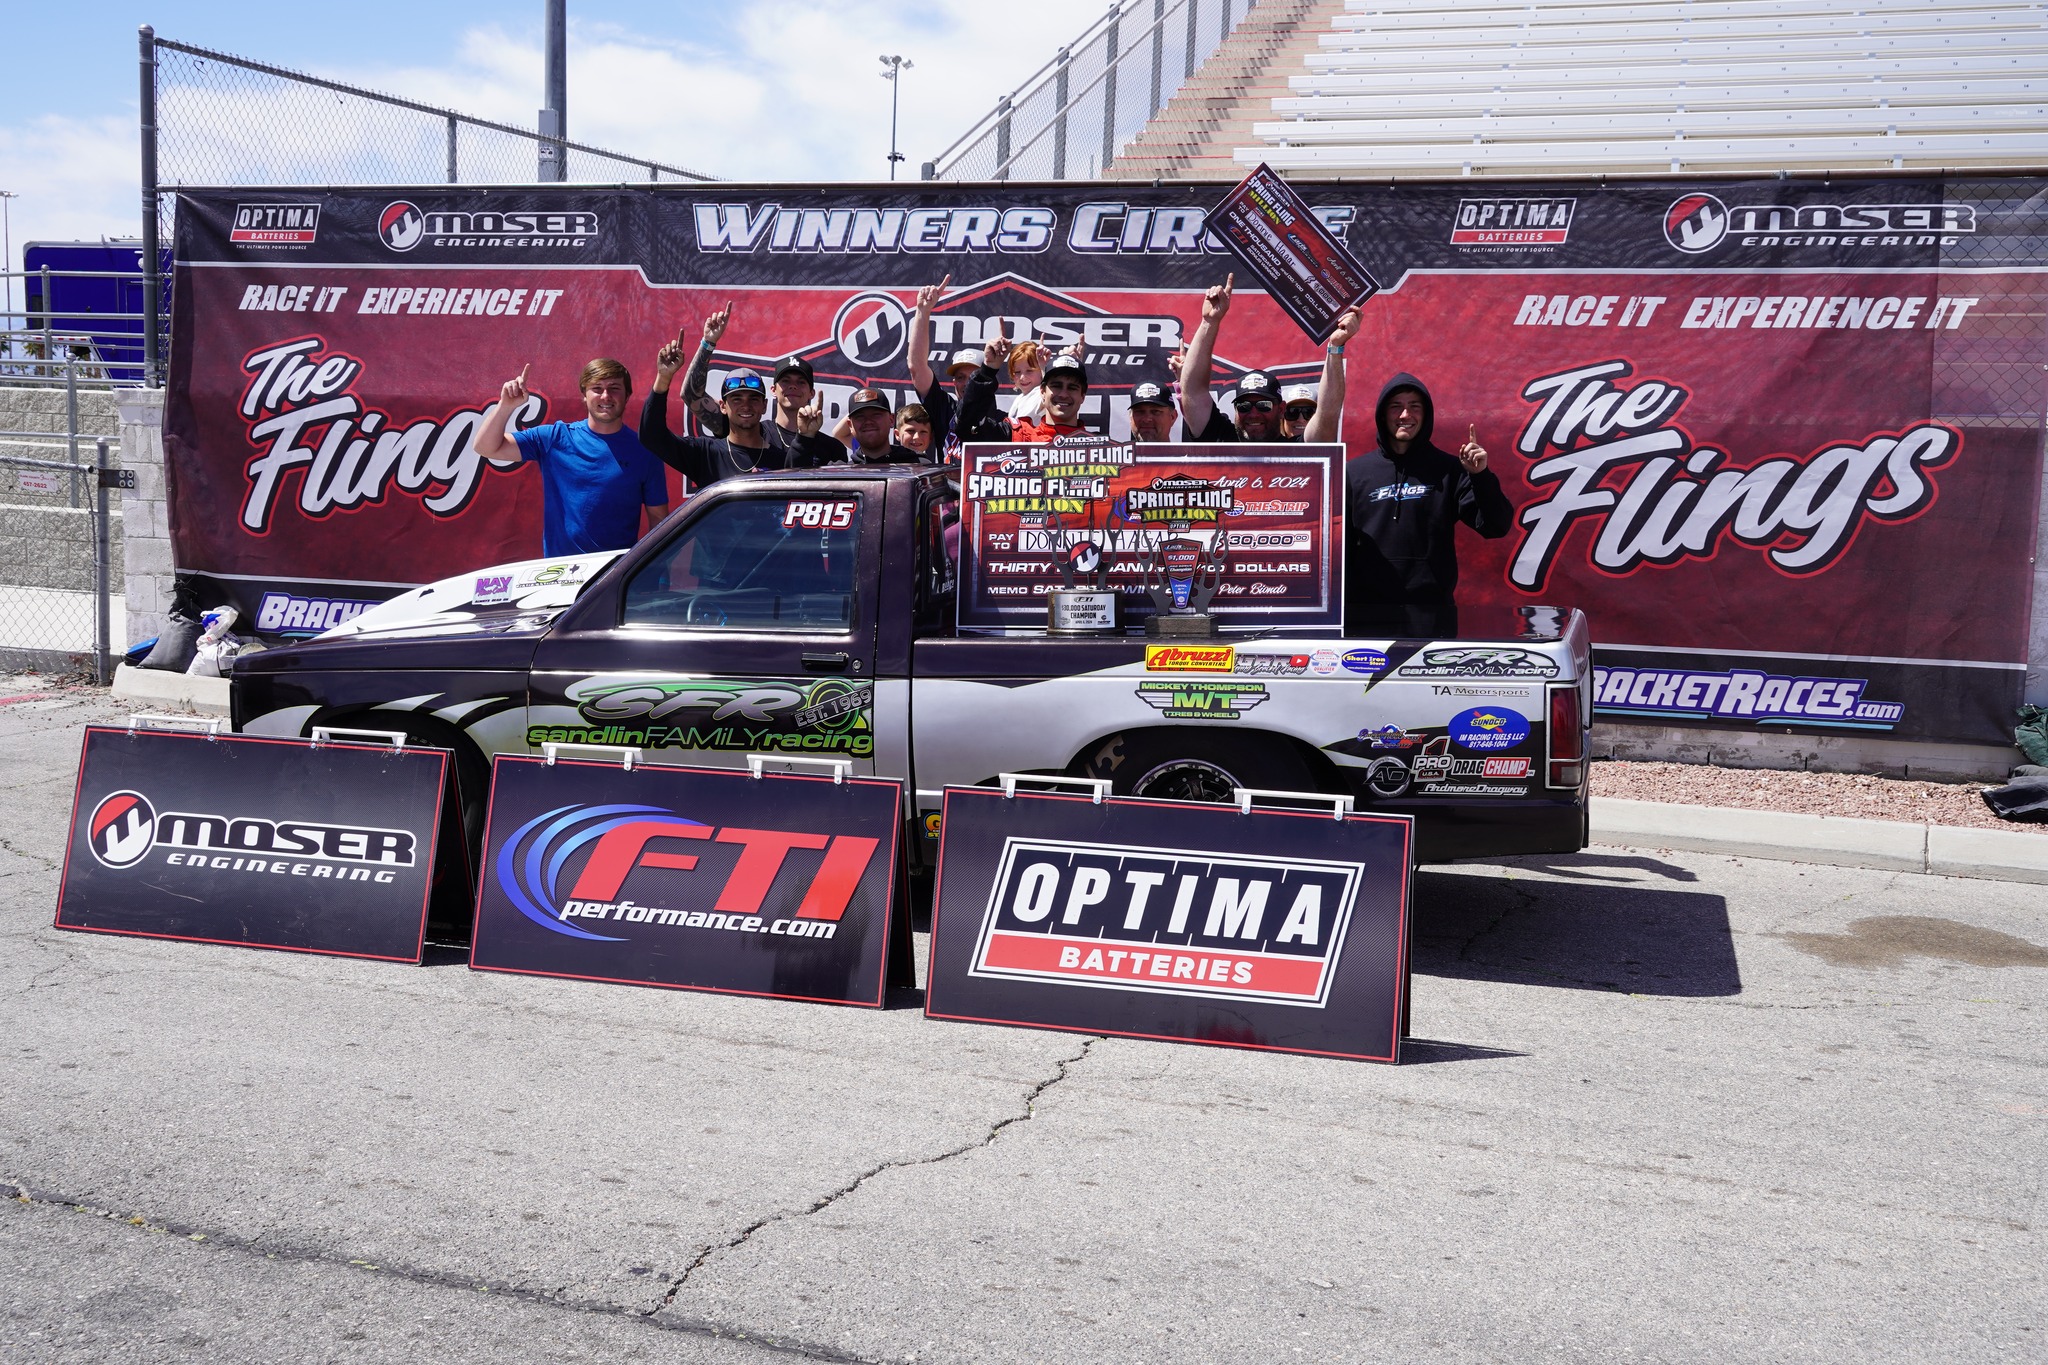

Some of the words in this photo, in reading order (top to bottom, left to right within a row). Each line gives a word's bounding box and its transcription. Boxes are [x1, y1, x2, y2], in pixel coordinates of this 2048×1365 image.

[1247, 176, 1277, 206] SPRING
[1271, 201, 1296, 226] FLING
[1248, 190, 1282, 225] MILLION
[239, 209, 313, 227] OPTIMA
[424, 213, 598, 235] MOSER
[1461, 204, 1566, 226] OPTIMA
[1727, 205, 1977, 233] MOSER
[694, 204, 1054, 252] WINNERS
[1068, 202, 1355, 254] CIRE
[434, 238, 586, 246] ENGINEERING
[1741, 236, 1959, 246] ENGINEERING
[1229, 211, 1245, 228] ONE
[1243, 226, 1282, 266] THOUSAND
[1304, 293, 1330, 320] DOLLARS
[240, 286, 314, 311] RACE
[314, 287, 347, 312] IT
[358, 288, 528, 315] EXPERIENCE
[527, 289, 563, 315] IT
[1514, 296, 1618, 326] RACE
[1617, 296, 1667, 327] IT
[1680, 297, 1929, 329] EXPERIENCE
[1925, 298, 1978, 330] IT
[909, 316, 1181, 347] MOSER
[244, 340, 356, 414] The
[1520, 362, 1680, 453] The
[244, 396, 543, 528] Flings
[992, 452, 1012, 461] RACE
[1031, 448, 1085, 466] SPRING
[1090, 445, 1133, 463] FLING
[1044, 466, 1120, 477] MILLION
[1209, 476, 1249, 489] April
[1269, 476, 1310, 489] 2024
[969, 475, 1042, 498] SPRING
[986, 500, 1085, 513] MILLION
[1130, 491, 1184, 508] SPRING
[1189, 489, 1231, 508] FLING
[1510, 427, 1951, 586] Flings
[784, 502, 854, 526] P815
[1143, 509, 1217, 521] MILLION
[989, 563, 1052, 572] THIRTY
[1236, 564, 1310, 572] DOLLARS
[476, 577, 512, 594] MAY
[1219, 584, 1247, 595] Peter
[1250, 583, 1286, 595] Biondo
[1149, 648, 1231, 666] Abruzzi
[1174, 692, 1237, 709] M/T
[1432, 686, 1452, 695] TA
[1455, 687, 1529, 696] Motorsports
[1594, 671, 1902, 719] RACKETRACES.com
[583, 687, 801, 721] SFR
[797, 706, 824, 727] EST.
[830, 691, 870, 716] 1969
[1416, 758, 1450, 769] PRO
[1453, 761, 1484, 774] DRAG
[1486, 761, 1526, 775] CHAMP
[157, 813, 416, 867] MOSER
[167, 854, 396, 884] ENGINEERING
[570, 822, 879, 920] FTI
[1013, 862, 1322, 946] OPTIMA
[558, 901, 836, 938] performance.com
[1059, 947, 1253, 984] BATTERIES
